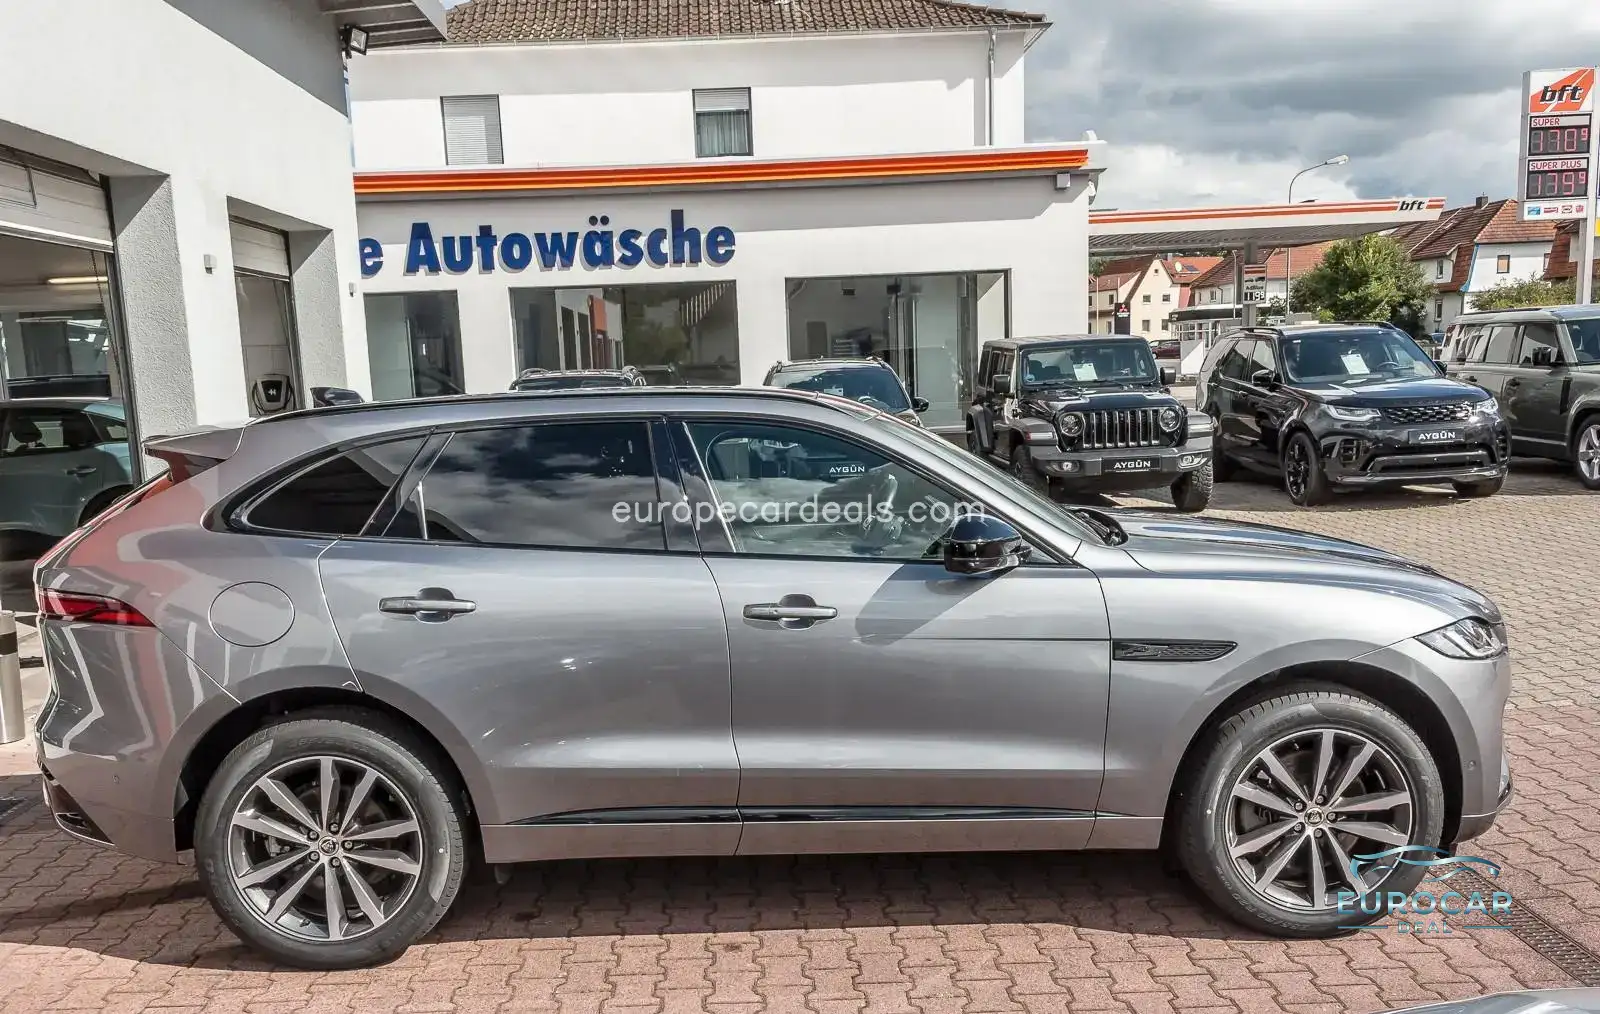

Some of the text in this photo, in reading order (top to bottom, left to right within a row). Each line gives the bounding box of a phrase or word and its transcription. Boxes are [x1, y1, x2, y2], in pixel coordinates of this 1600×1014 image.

[1540, 85, 1583, 102] bft
[1533, 118, 1560, 127] SUPER
[1530, 160, 1582, 170] SUPER PLUS
[1399, 200, 1425, 211] bft
[404, 209, 736, 275] Autowäsche
[1419, 431, 1456, 440] AYGÜN
[829, 464, 865, 473] AYGÜN
[1113, 460, 1151, 469] AYGÜN
